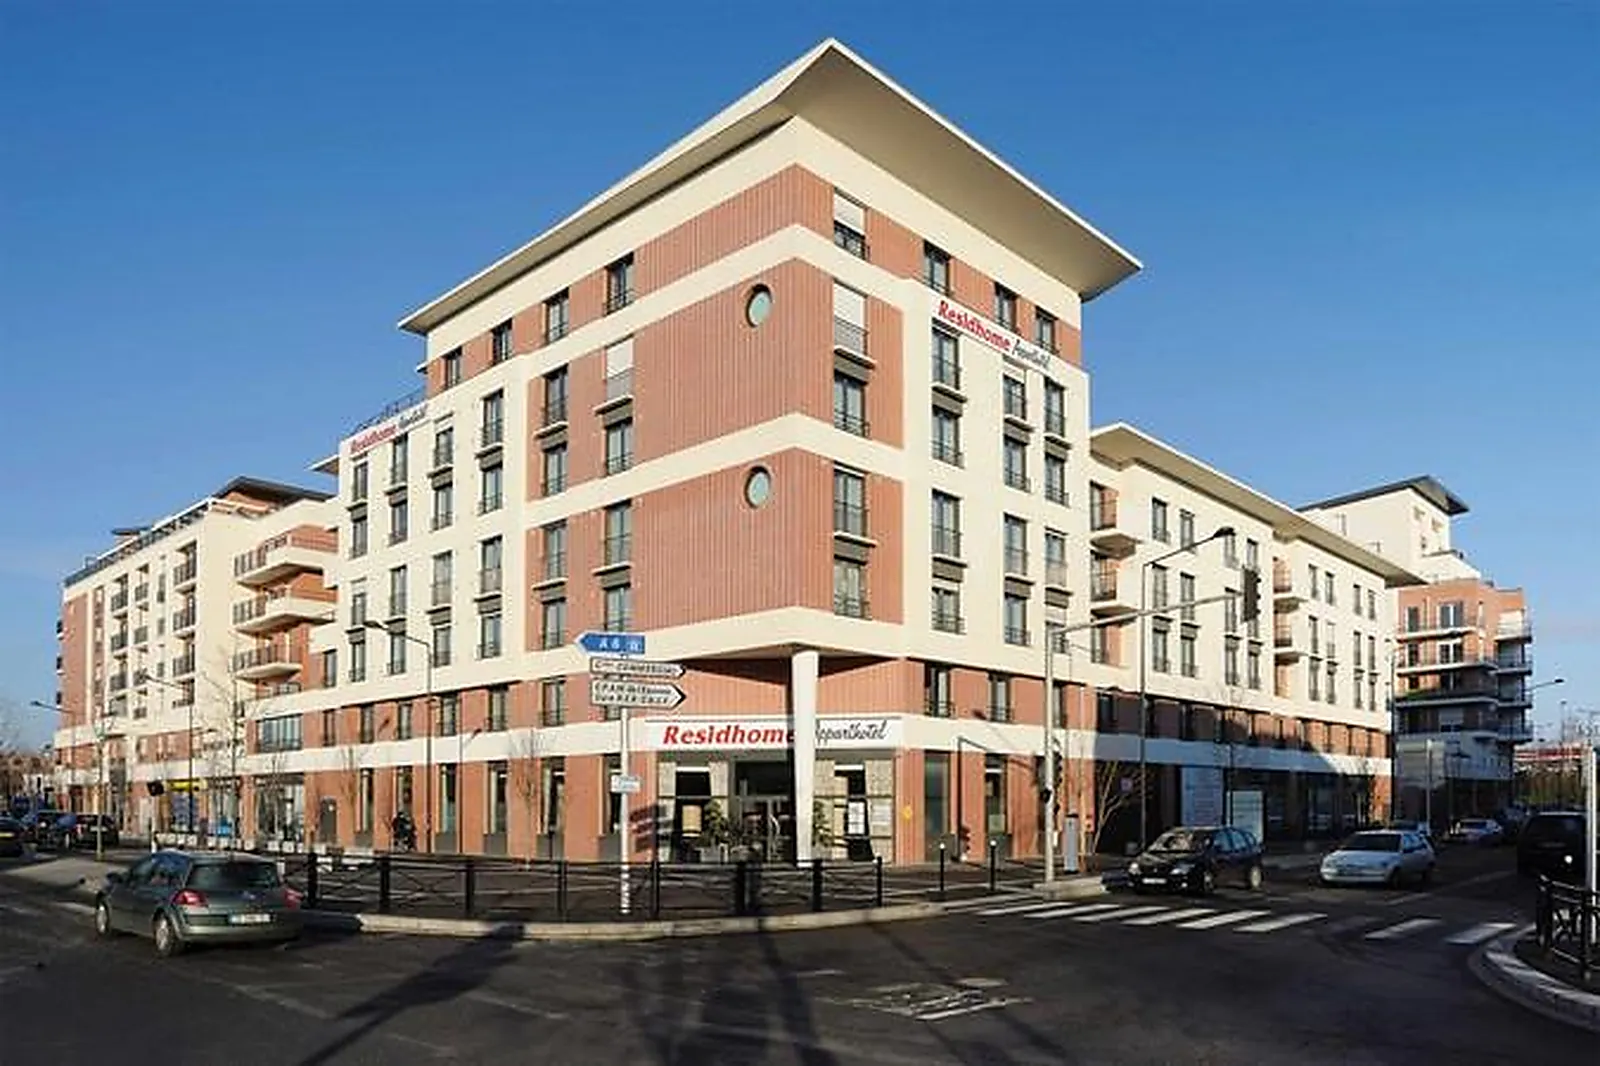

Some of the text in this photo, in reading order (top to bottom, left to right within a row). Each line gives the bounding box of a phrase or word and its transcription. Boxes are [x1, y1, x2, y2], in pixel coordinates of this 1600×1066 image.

[938, 300, 1011, 352] Residhome
[663, 719, 888, 746] Residhome pparthotel
